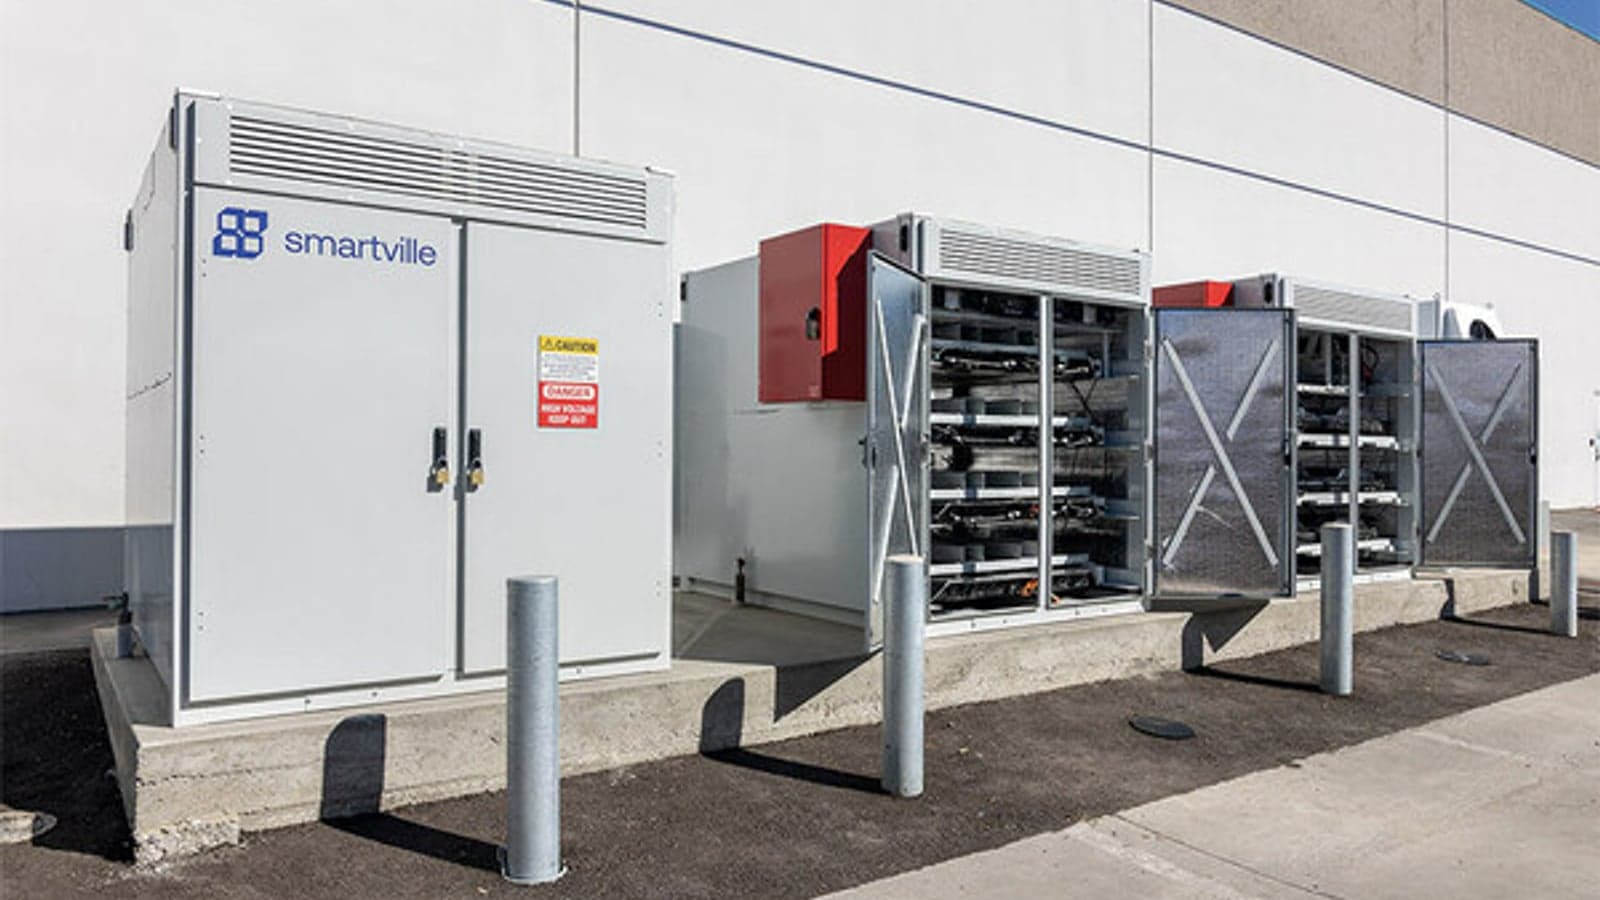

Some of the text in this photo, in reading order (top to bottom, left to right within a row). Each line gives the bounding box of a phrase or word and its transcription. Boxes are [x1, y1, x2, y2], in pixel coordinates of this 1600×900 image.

[284, 231, 437, 266] smartville
[555, 339, 596, 353] CAUTION
[546, 384, 591, 397] DANGER
[541, 403, 596, 416] HIGH VOLTAGE
